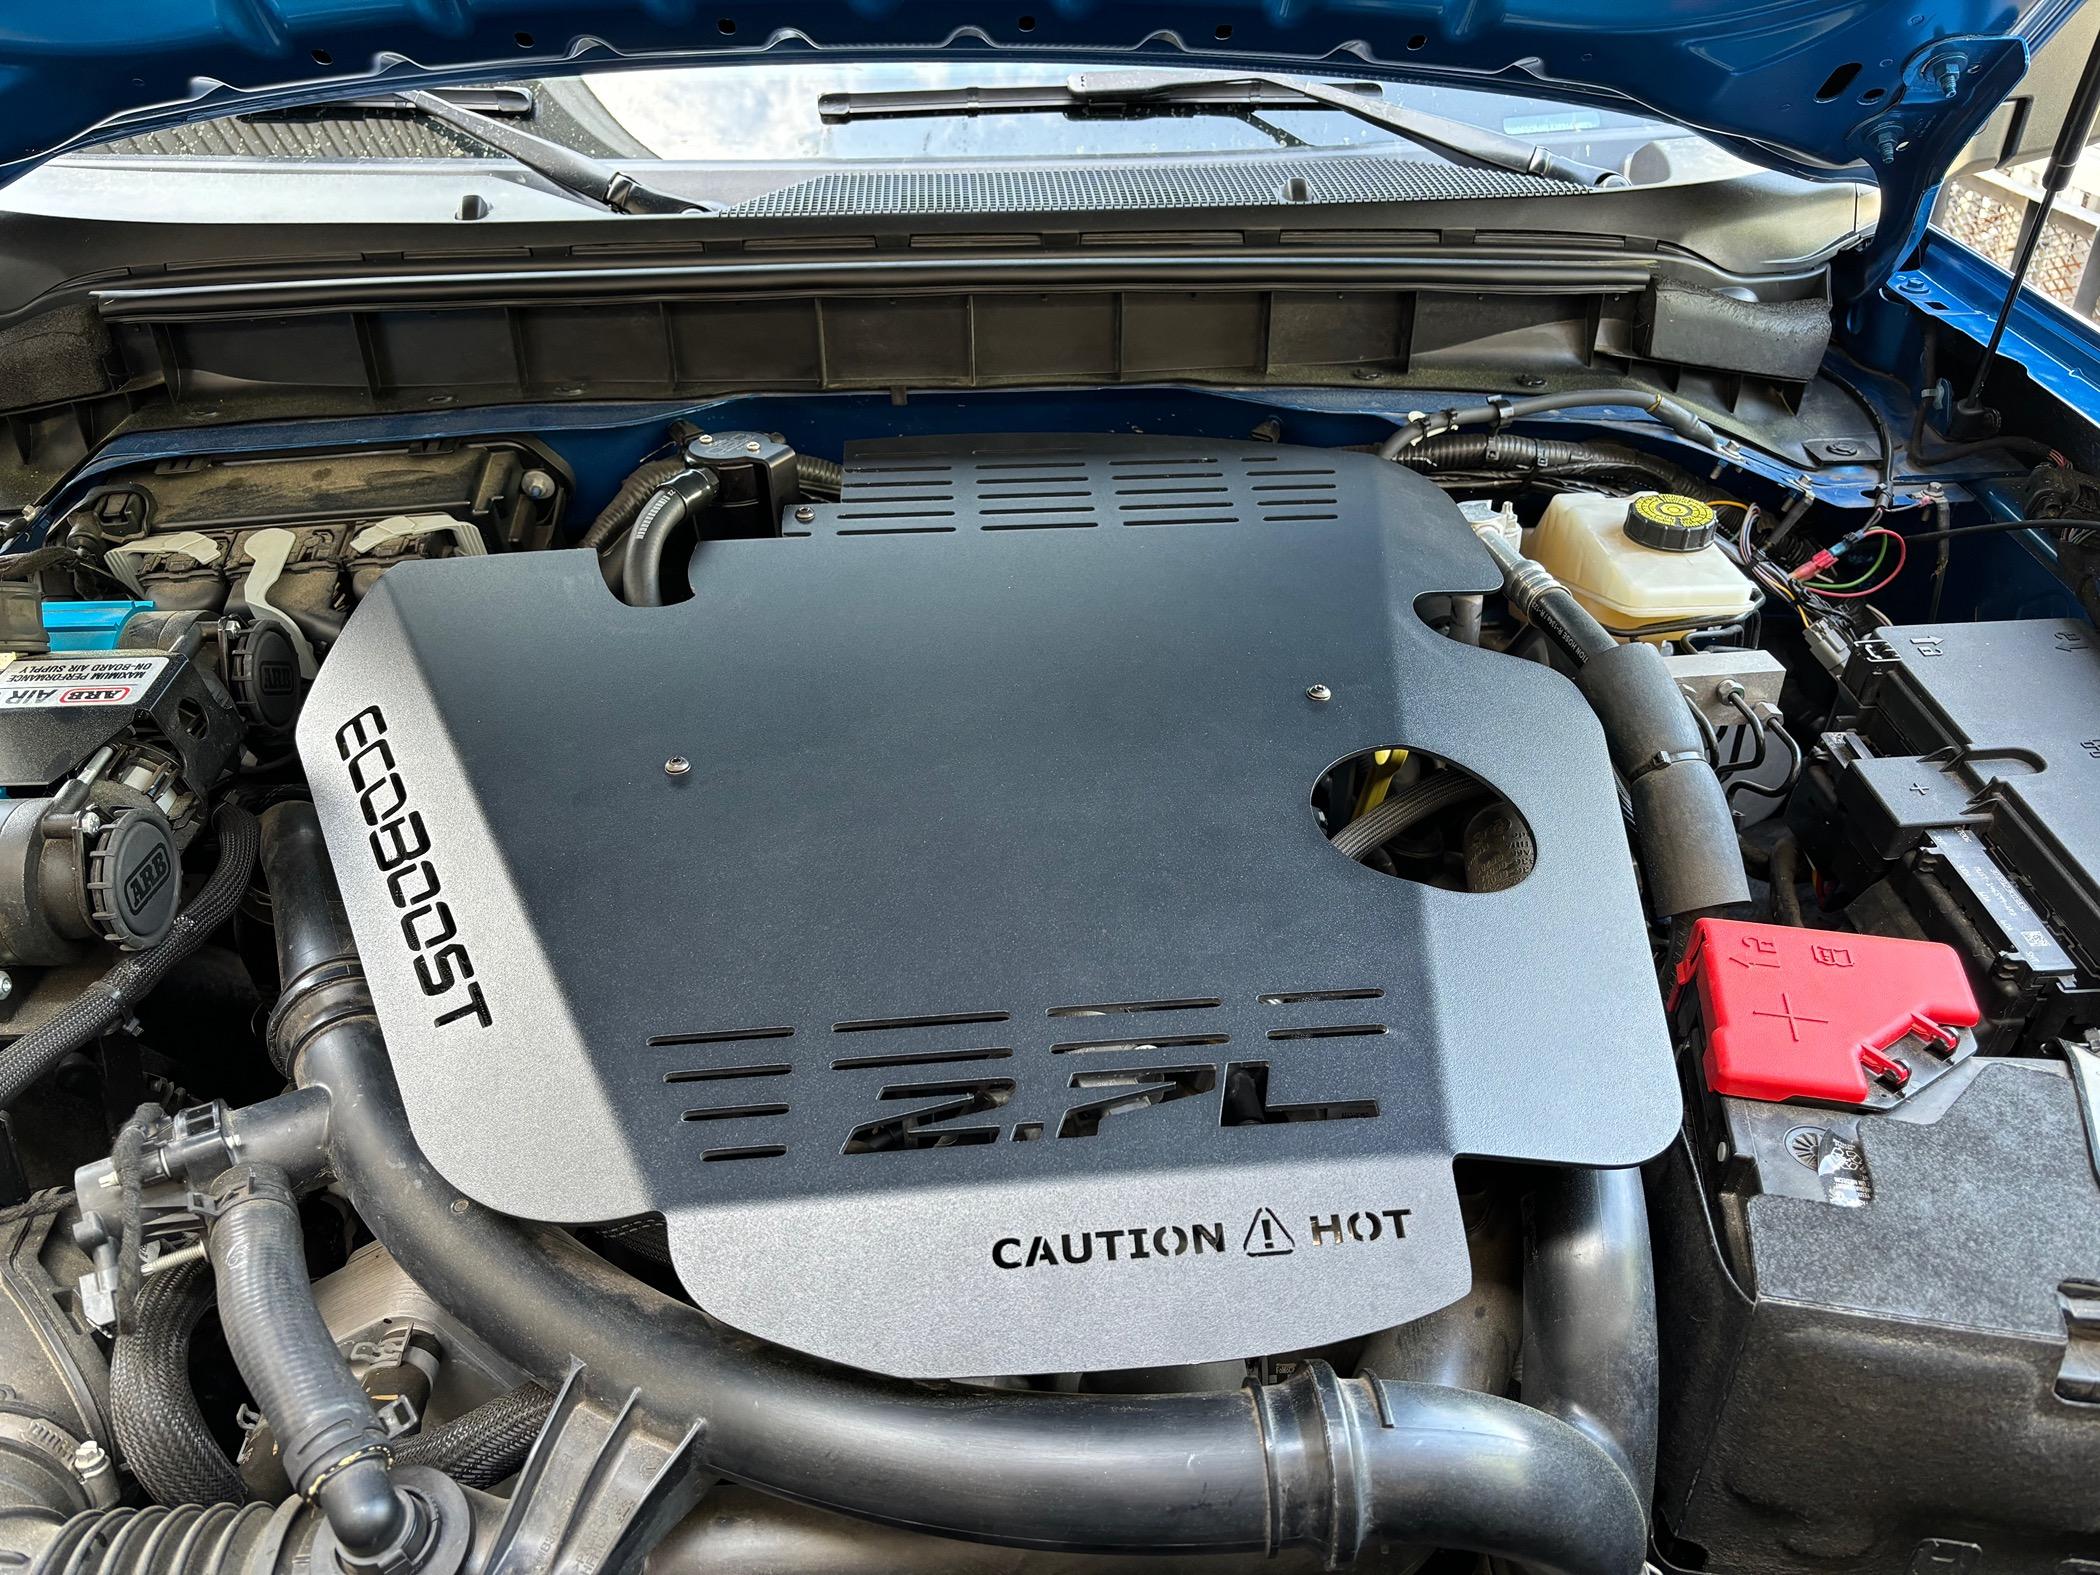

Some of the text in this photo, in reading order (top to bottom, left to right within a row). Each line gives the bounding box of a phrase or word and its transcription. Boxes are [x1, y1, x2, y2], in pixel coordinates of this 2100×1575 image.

[6, 671, 147, 683] MAXIMUM PERFORMANCE
[19, 662, 153, 674] ON-BOARD AIR SUPPLY
[262, 665, 292, 689] ARB
[5, 688, 123, 704] ARB AIR
[130, 852, 170, 909] ARB
[335, 705, 493, 1028] ECOBOOST
[839, 1060, 1381, 1155] 2.7L
[992, 1208, 1413, 1270] CAUTION HOT
